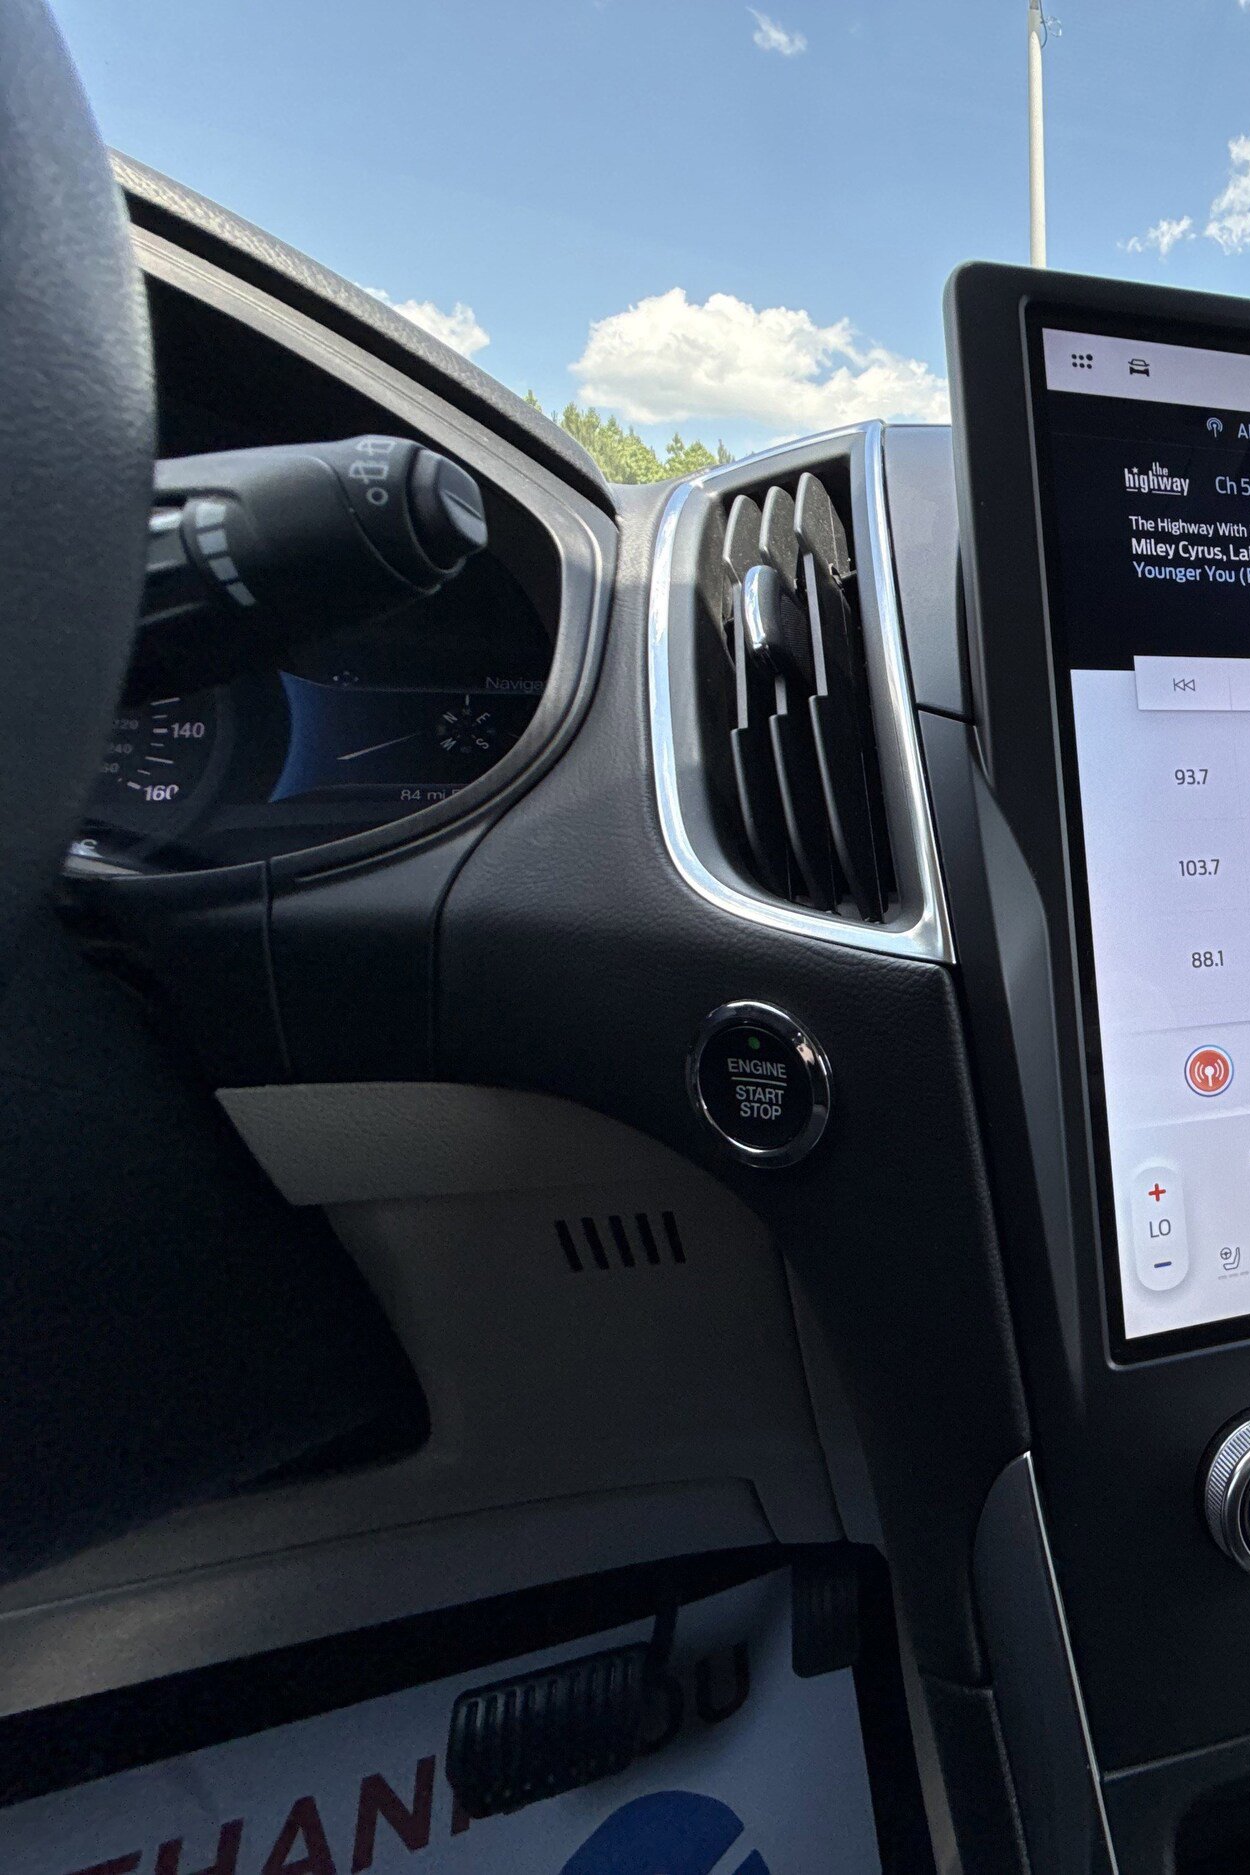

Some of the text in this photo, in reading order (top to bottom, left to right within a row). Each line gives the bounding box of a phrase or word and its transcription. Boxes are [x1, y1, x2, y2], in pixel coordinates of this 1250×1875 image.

[1152, 461, 1169, 477] the
[1124, 467, 1190, 497] highway
[1214, 475, 1238, 495] Ch
[1128, 515, 1155, 531] The
[1157, 517, 1215, 538] Highway
[1216, 521, 1248, 538] With
[1130, 537, 1176, 560] Miley
[1178, 540, 1228, 562] Cyrus,
[1132, 560, 1202, 584] Younger
[1204, 564, 1236, 583] You
[170, 721, 206, 739] 140
[1174, 768, 1209, 786] 93.7
[143, 784, 180, 801] 160
[400, 788, 422, 801] 84
[1178, 858, 1221, 877] 103.7
[1190, 950, 1224, 969] 88.1
[727, 1057, 788, 1079] ENGINE
[735, 1084, 785, 1105] START
[739, 1101, 782, 1120] STOP
[1148, 1217, 1172, 1239] LO
